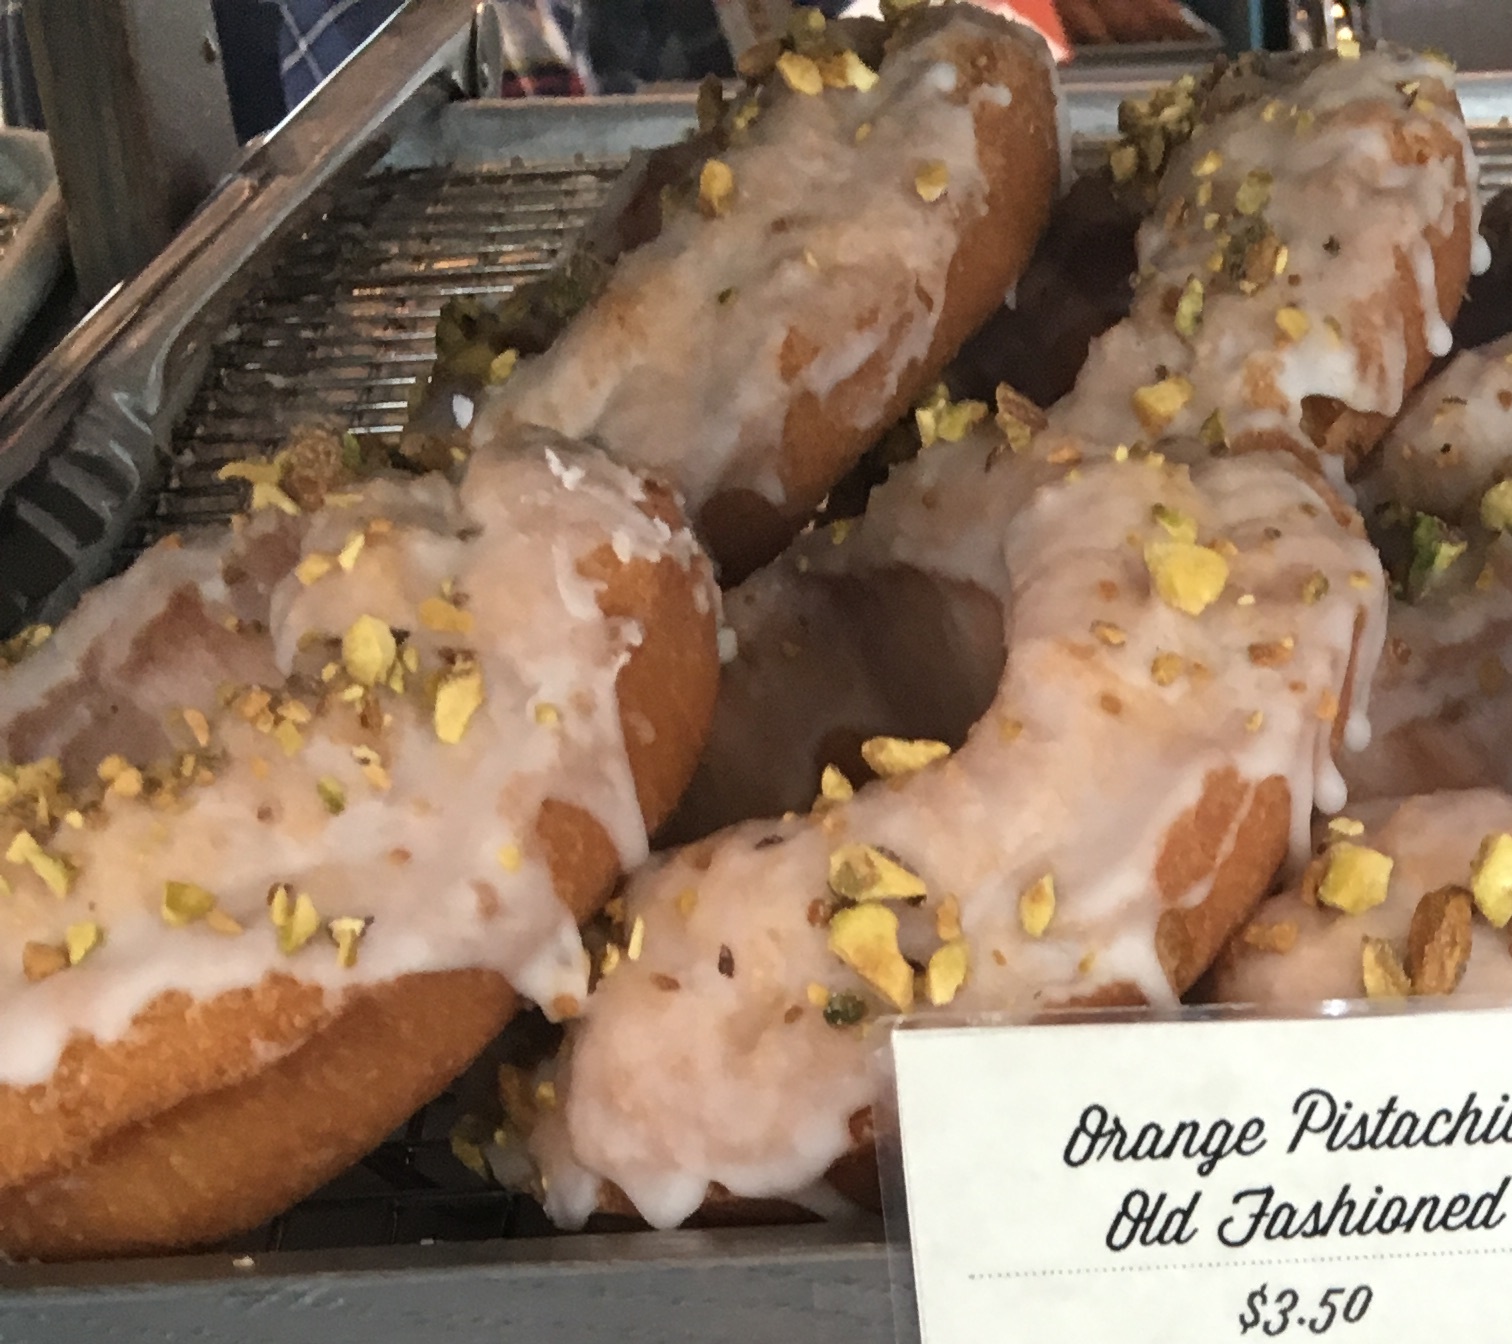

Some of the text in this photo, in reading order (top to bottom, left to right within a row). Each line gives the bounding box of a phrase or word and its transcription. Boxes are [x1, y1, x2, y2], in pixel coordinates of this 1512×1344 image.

[1063, 1104, 1267, 1176] Orange
[1105, 1176, 1511, 1251] Old Fashioned
[1239, 1283, 1373, 1336] $3.50
